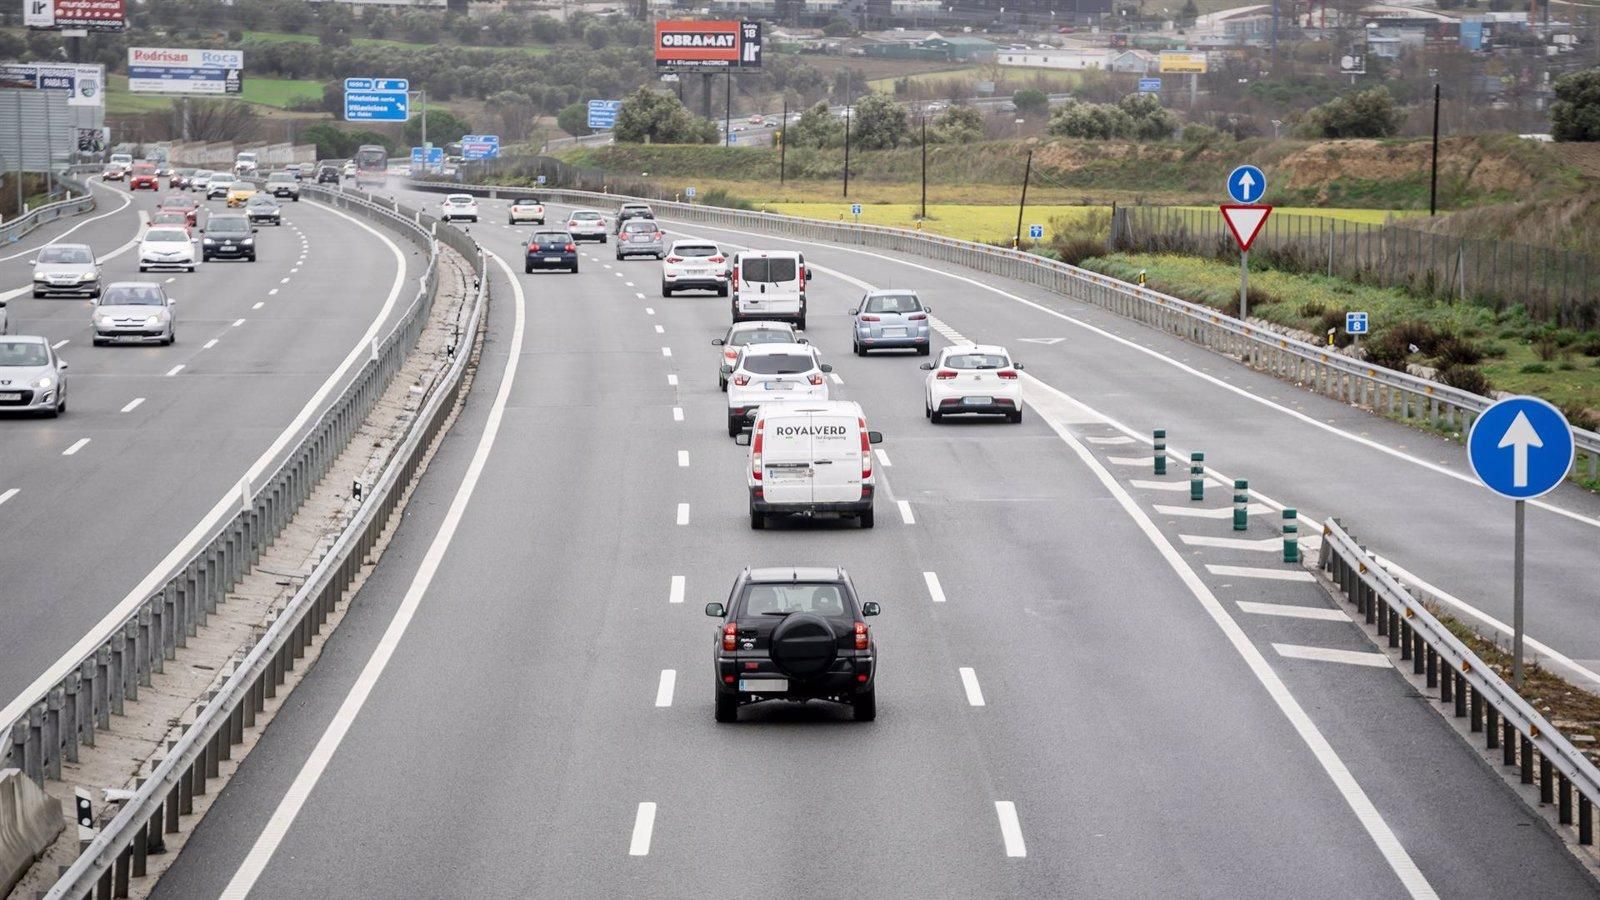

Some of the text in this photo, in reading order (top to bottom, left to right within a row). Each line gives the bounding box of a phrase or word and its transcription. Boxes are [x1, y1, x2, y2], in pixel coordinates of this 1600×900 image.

[59, 0, 120, 9] mundo animal
[744, 29, 756, 38] 18
[662, 34, 734, 46] OBRAMAT
[134, 50, 238, 62] Rodrisan Roca
[1353, 321, 1361, 330] 8
[776, 426, 847, 436] ROYALVERD
